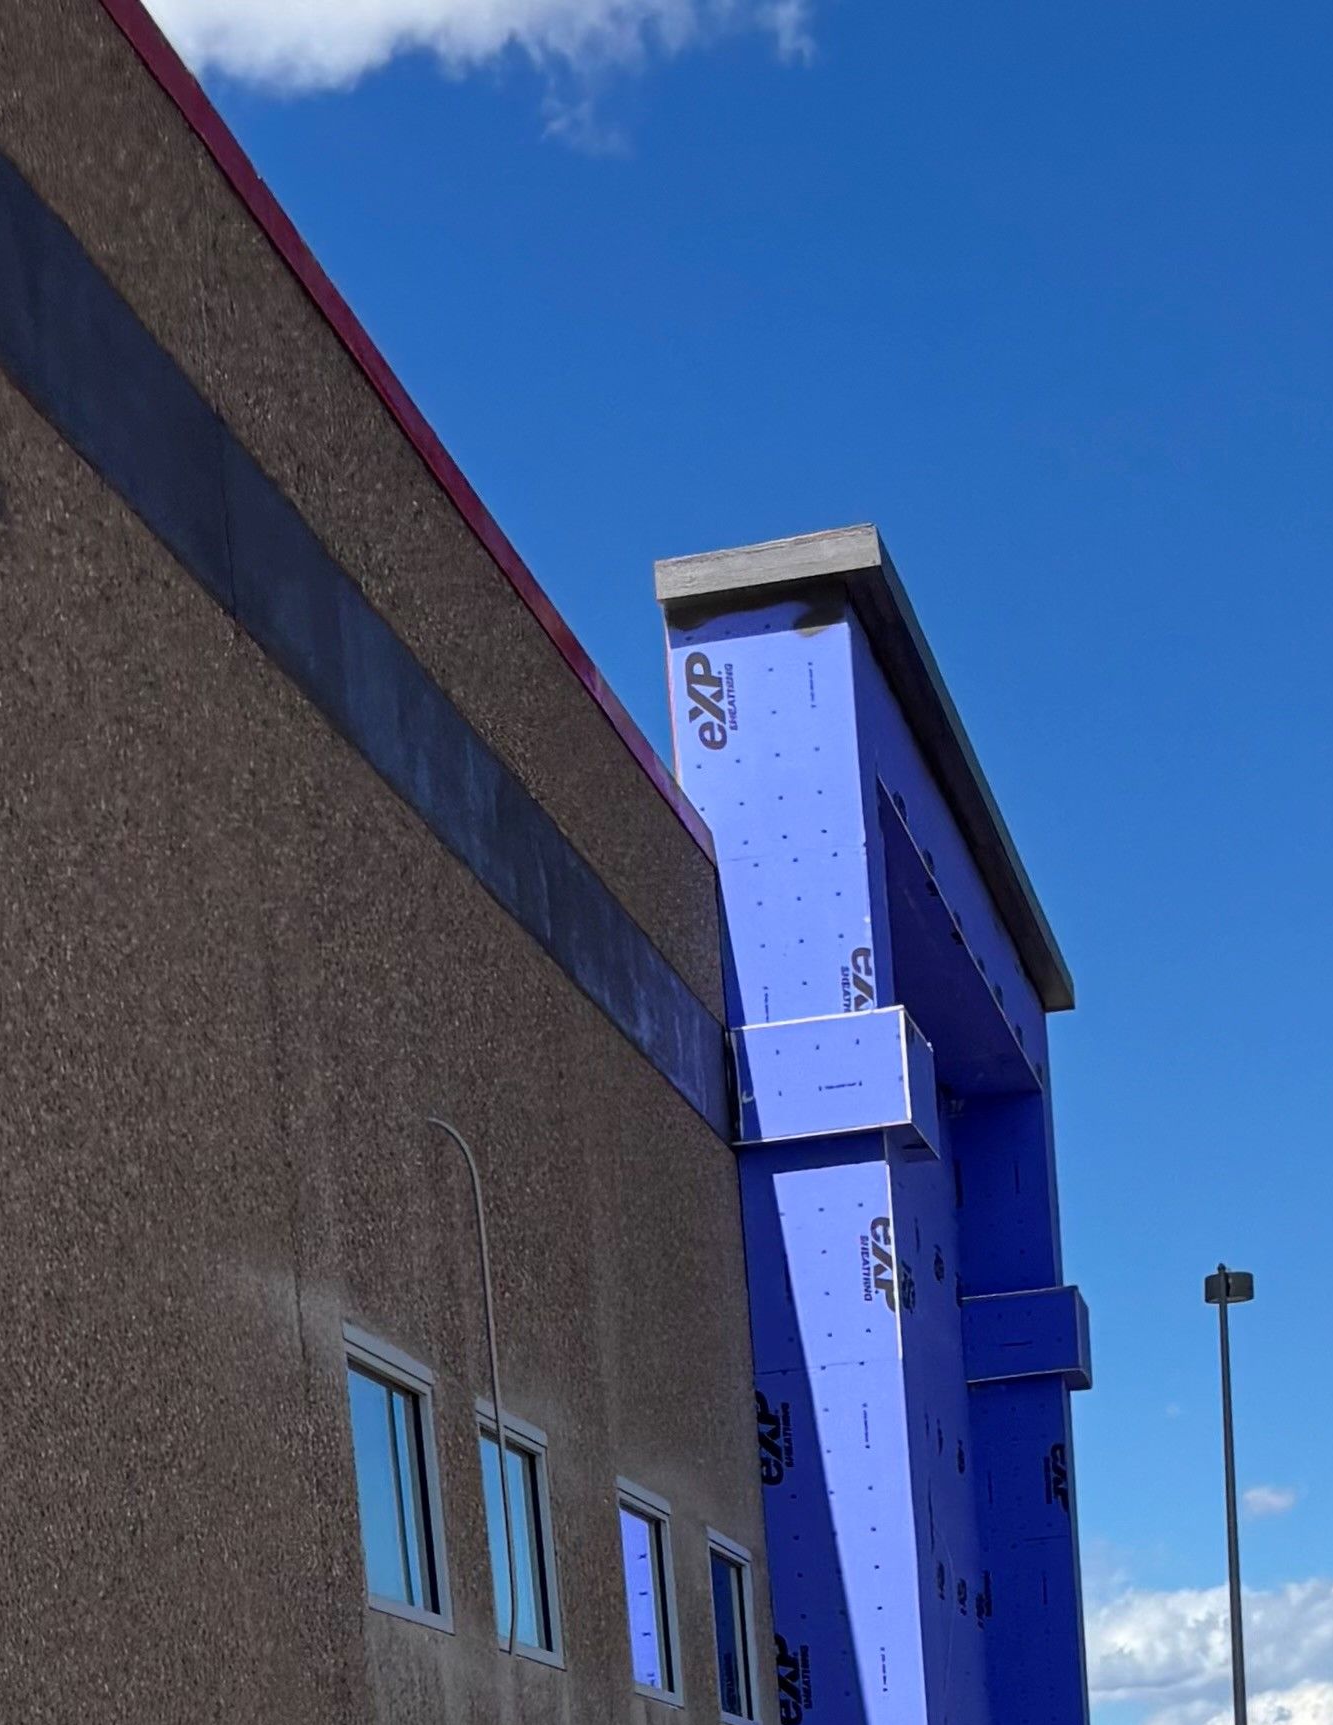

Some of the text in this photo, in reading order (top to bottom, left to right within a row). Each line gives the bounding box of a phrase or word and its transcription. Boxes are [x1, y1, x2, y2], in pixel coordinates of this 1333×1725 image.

[685, 651, 728, 751] eXP
[724, 663, 739, 731] SHEATHING
[851, 946, 875, 1012] eX
[859, 1234, 873, 1301] SHEATHING
